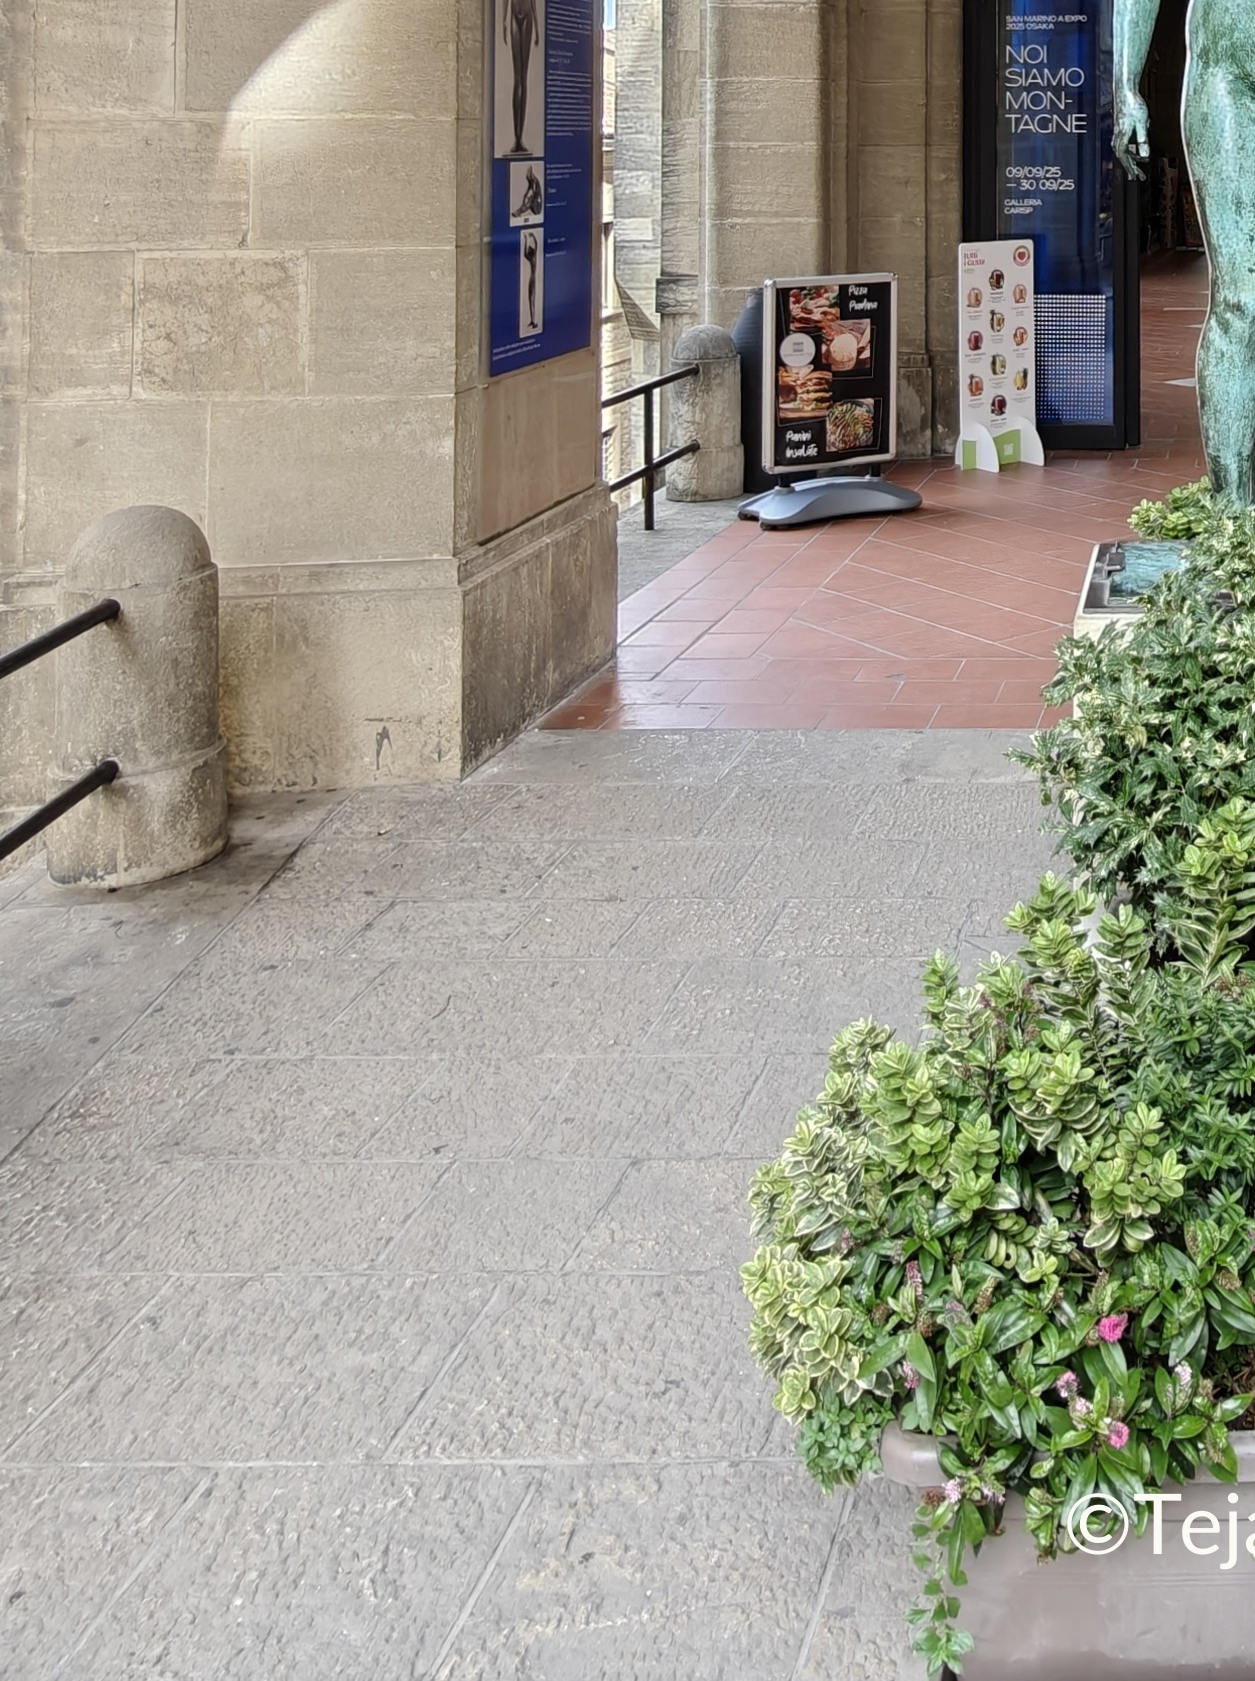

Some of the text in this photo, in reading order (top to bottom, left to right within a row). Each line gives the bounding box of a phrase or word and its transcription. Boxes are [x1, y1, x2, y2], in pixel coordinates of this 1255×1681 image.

[1005, 45, 1047, 64] NOI
[1004, 67, 1085, 88] SIAMO
[1005, 90, 1073, 110] MON-
[1004, 114, 1088, 134] TAGNE
[1005, 166, 1062, 179] 09/09/25
[848, 285, 868, 297] Pizza
[786, 430, 812, 442] Panini
[786, 444, 819, 458] Insalate
